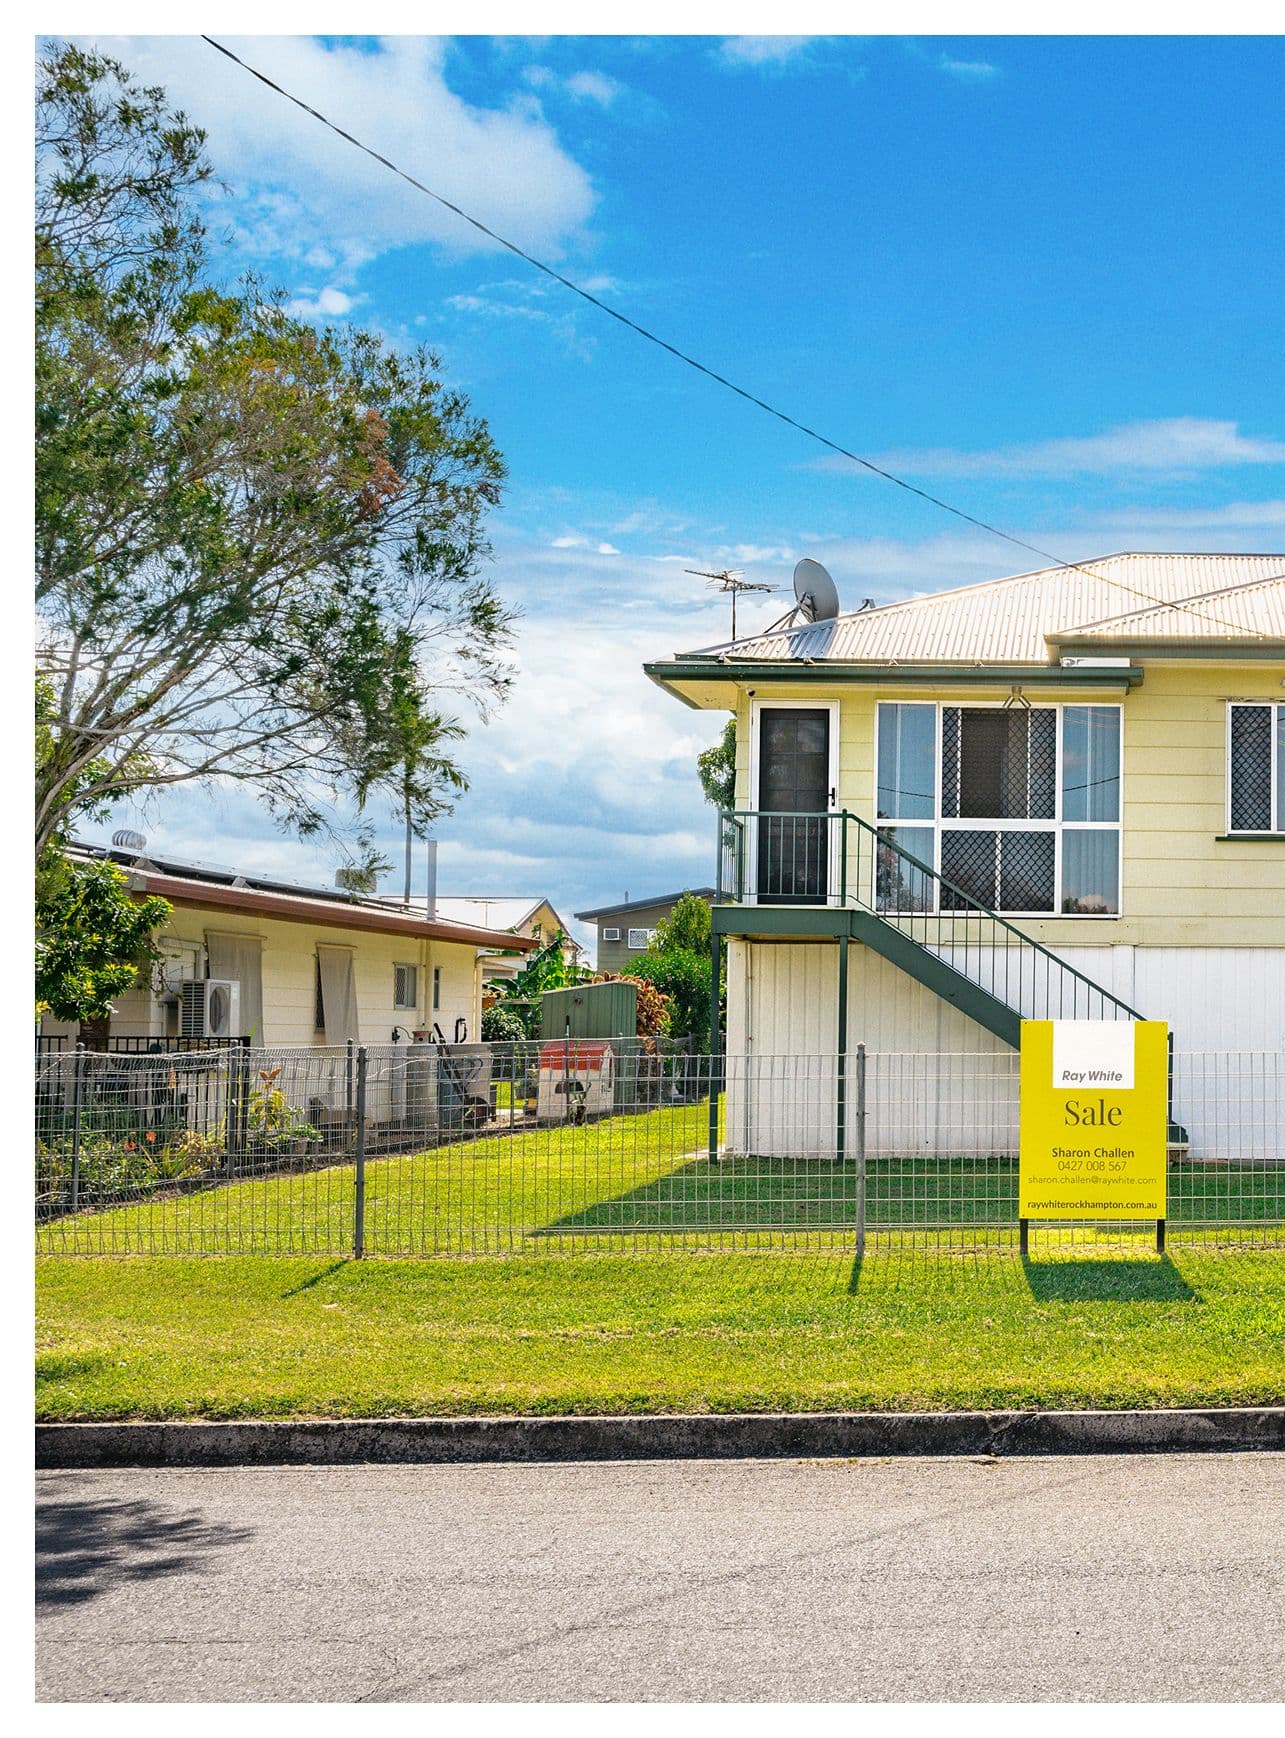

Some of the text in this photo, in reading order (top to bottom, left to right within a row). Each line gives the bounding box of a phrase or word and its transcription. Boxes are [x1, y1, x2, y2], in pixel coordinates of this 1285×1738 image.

[1062, 1070, 1123, 1083] Ray White
[1064, 1099, 1123, 1127] Sale
[1052, 1147, 1135, 1158] Sharon Challen
[1057, 1160, 1127, 1171] 0427 008 567
[1028, 1175, 1157, 1186] sharon.challen@raywhite.com
[1027, 1200, 1158, 1210] raywhiterockhampton.com.au
